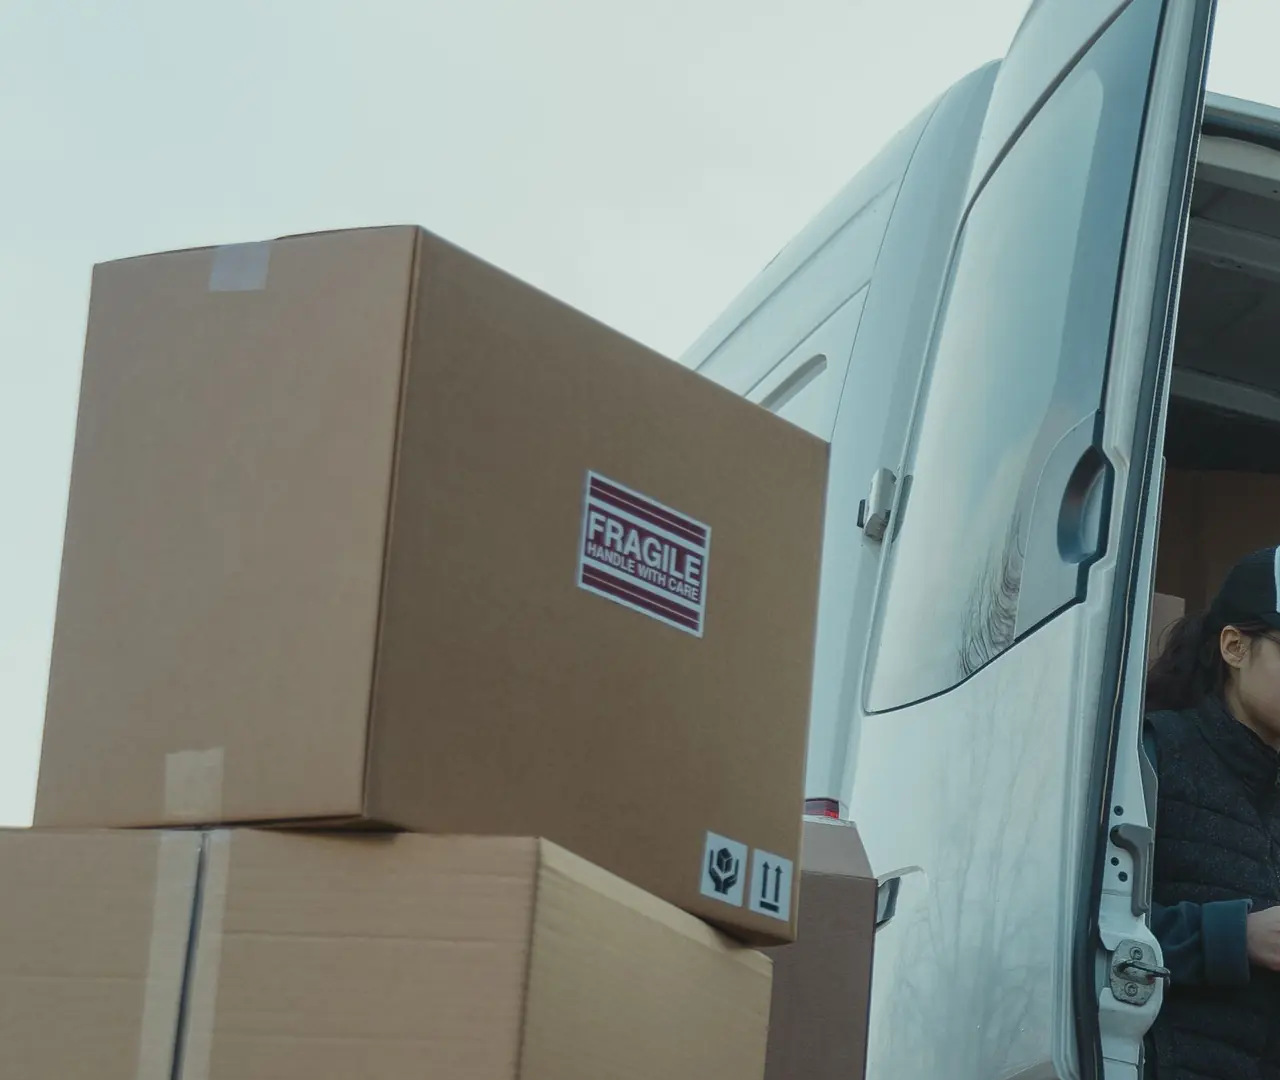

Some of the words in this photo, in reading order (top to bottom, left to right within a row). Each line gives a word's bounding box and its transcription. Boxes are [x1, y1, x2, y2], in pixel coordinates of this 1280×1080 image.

[586, 541, 635, 574] HANDLE
[637, 563, 667, 587] WITH
[668, 577, 699, 601] CARE
[587, 511, 701, 586] FRAGILE
